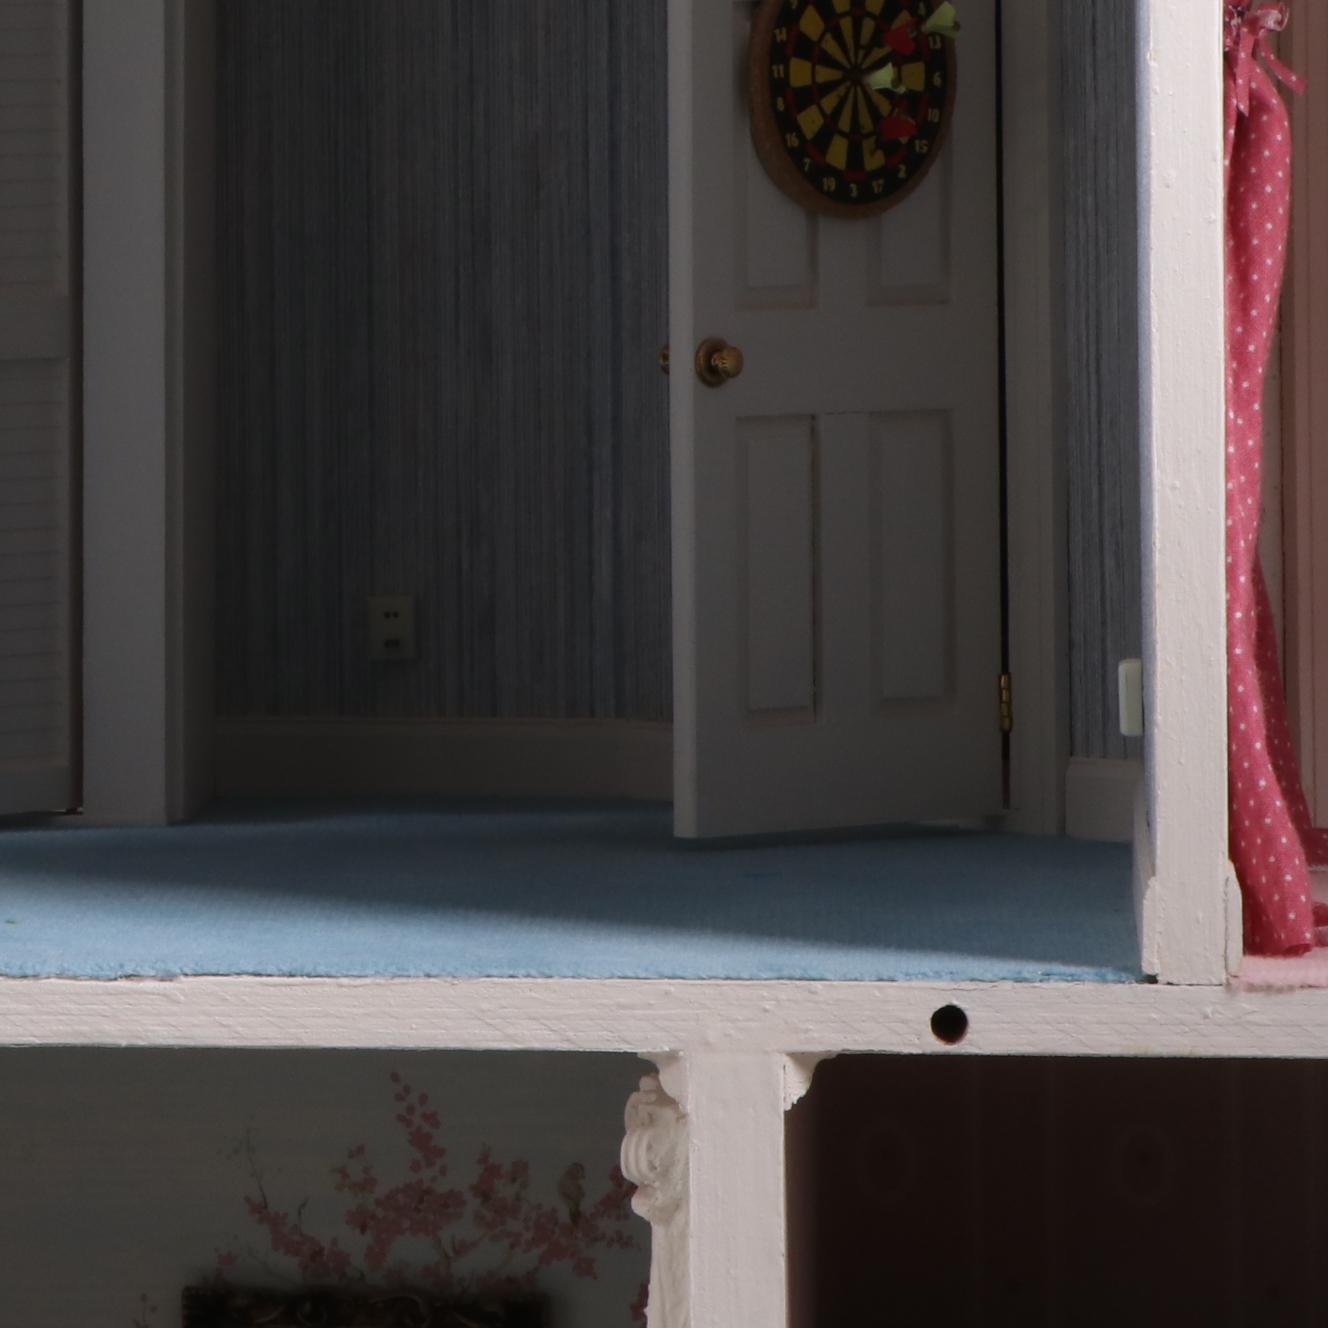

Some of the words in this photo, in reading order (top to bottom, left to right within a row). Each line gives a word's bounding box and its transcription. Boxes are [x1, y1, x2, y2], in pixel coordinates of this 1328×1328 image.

[774, 27, 788, 43] 14
[771, 64, 785, 77] 11
[928, 107, 940, 122] 10
